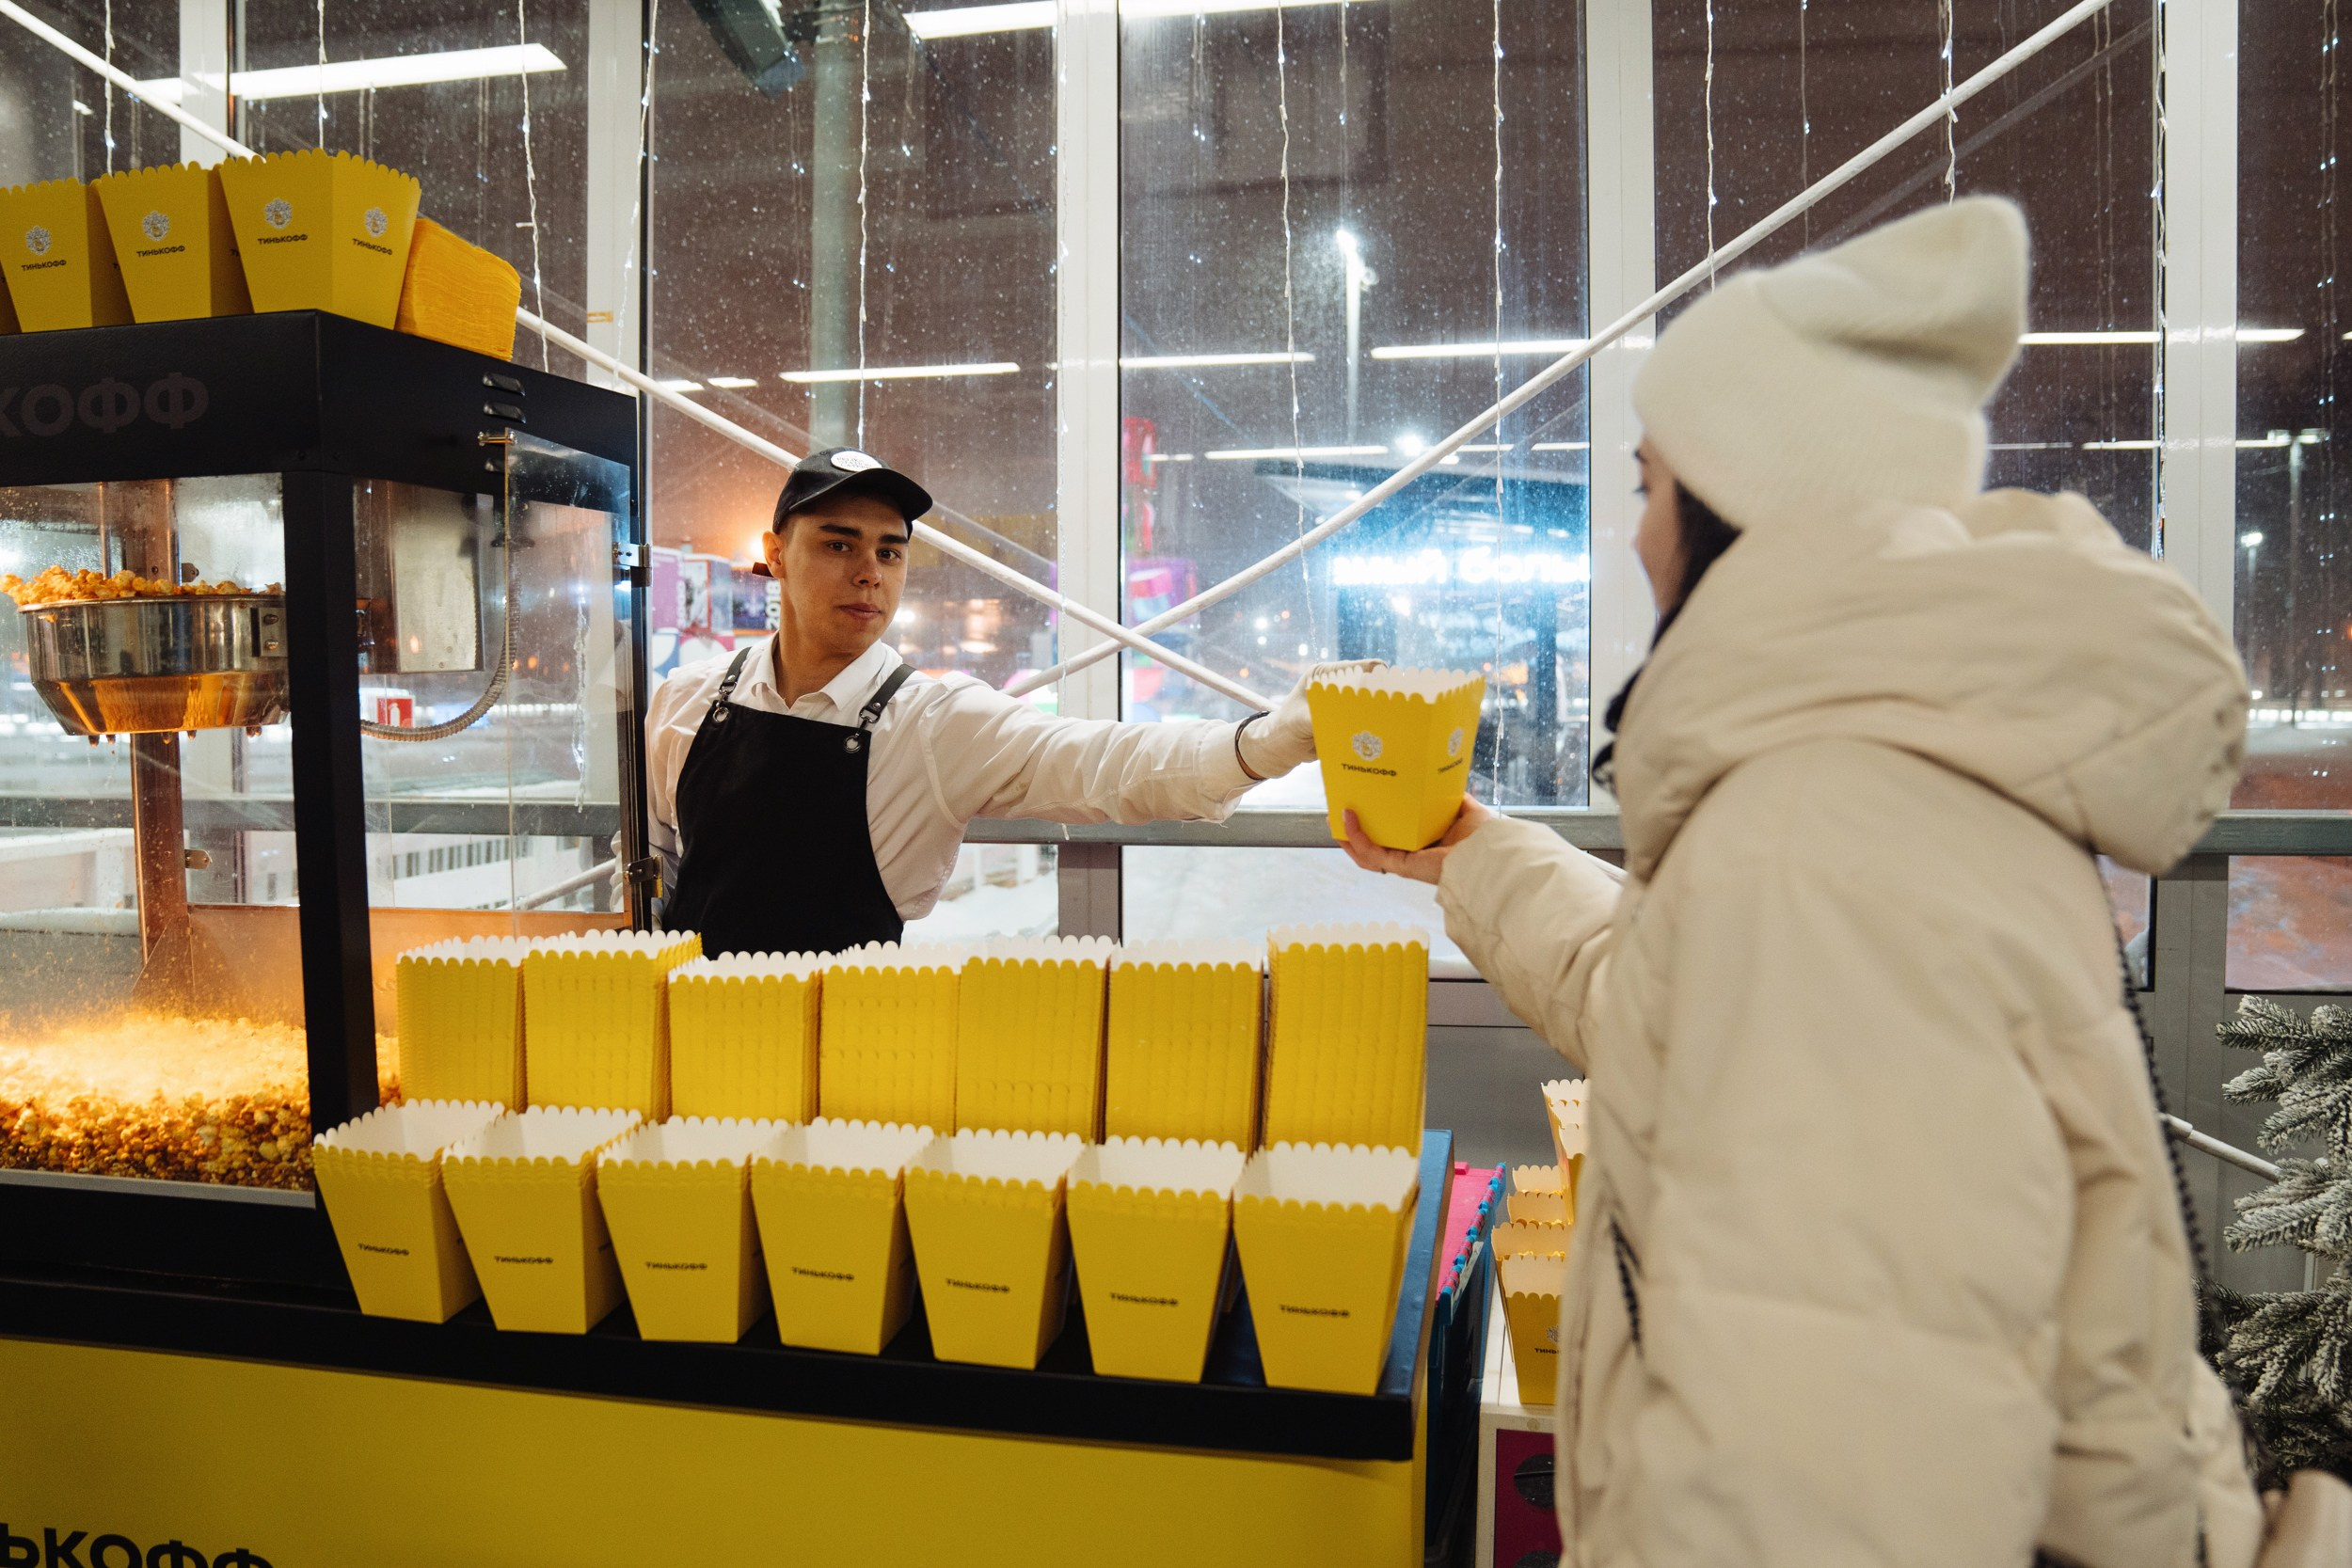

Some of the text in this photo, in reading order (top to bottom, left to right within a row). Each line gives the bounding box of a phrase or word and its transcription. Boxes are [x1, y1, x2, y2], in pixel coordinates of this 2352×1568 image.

[257, 234, 309, 245] ТИНЬКОФФ
[136, 245, 186, 258] ТИНЬКОФФ
[352, 237, 393, 256] ТИНЬКОФФ
[21, 259, 67, 272] ТИНЬКОФФ
[1341, 763, 1397, 777] ТИНЬКОФФ
[645, 1261, 707, 1271] ТИНЬКОФФ
[791, 1266, 854, 1282] ТИНЬКОФФ
